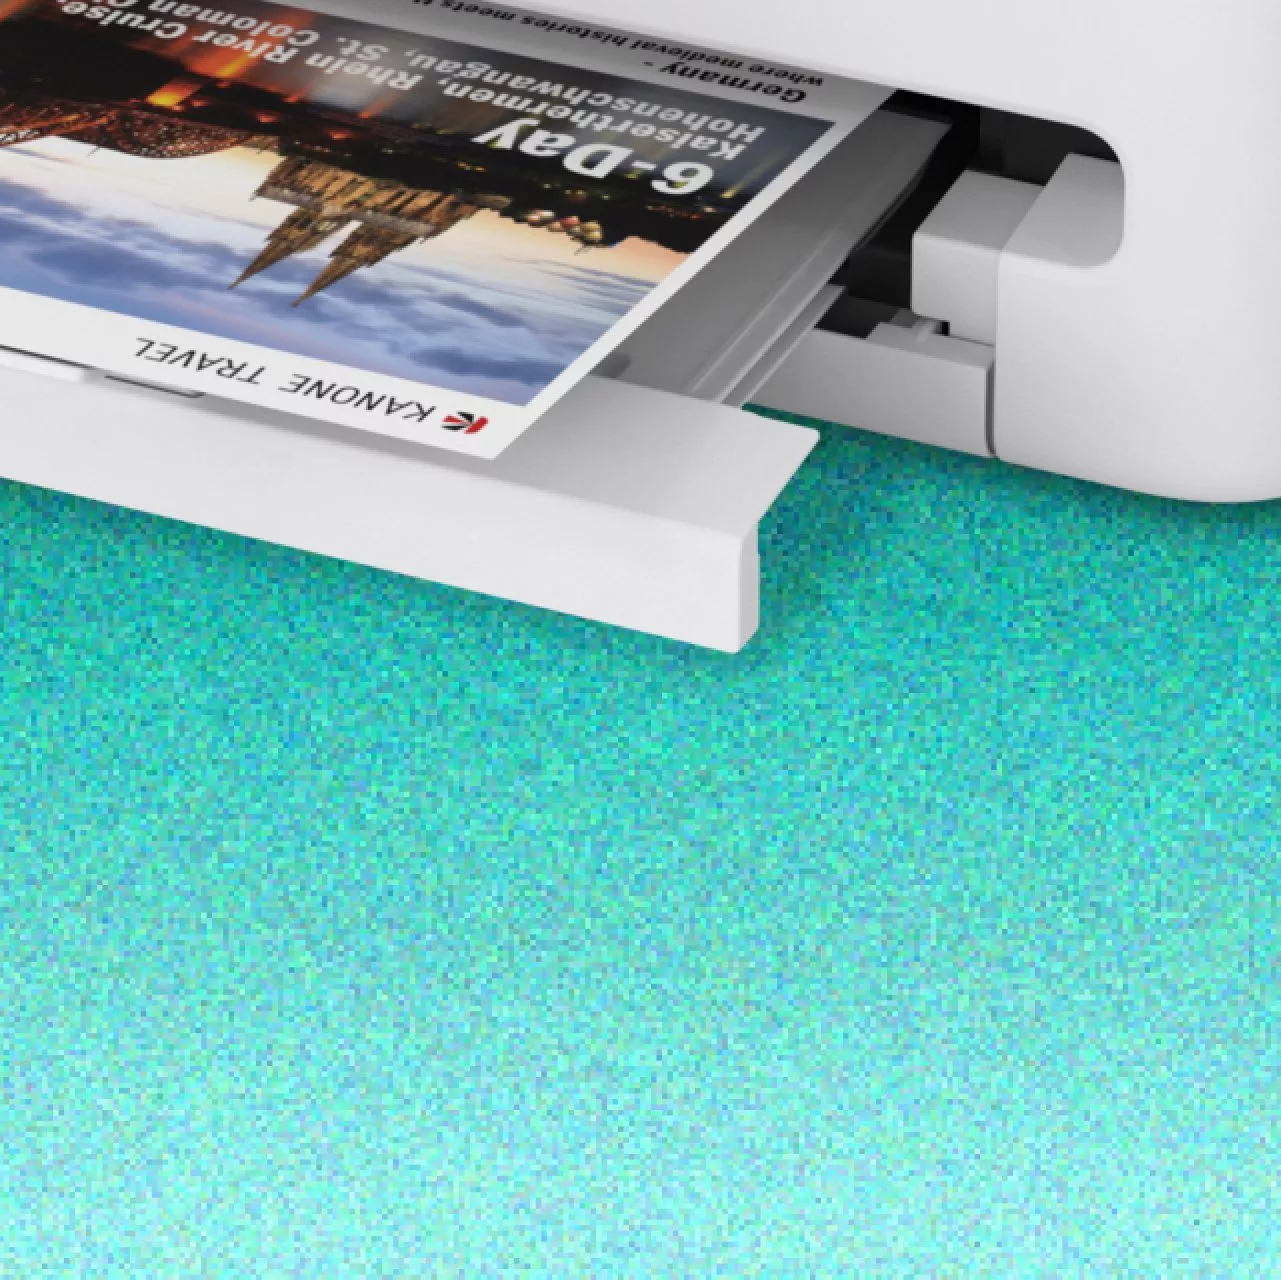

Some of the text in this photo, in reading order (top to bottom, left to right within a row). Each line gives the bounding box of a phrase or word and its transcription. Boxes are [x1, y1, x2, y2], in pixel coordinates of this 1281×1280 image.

[440, 0, 517, 21] meets
[192, 30, 301, 64] River
[521, 14, 629, 47] histories
[336, 36, 390, 62] St.
[630, 39, 745, 69] medieval
[305, 53, 424, 91] Rhein
[660, 61, 808, 104] Germany
[748, 62, 824, 87] where
[404, 48, 767, 143] Hohenschwangau,
[436, 77, 747, 161] Kaiserthermen,
[470, 117, 715, 196] 6-Day
[134, 337, 436, 423] KANONE TRAVEL
